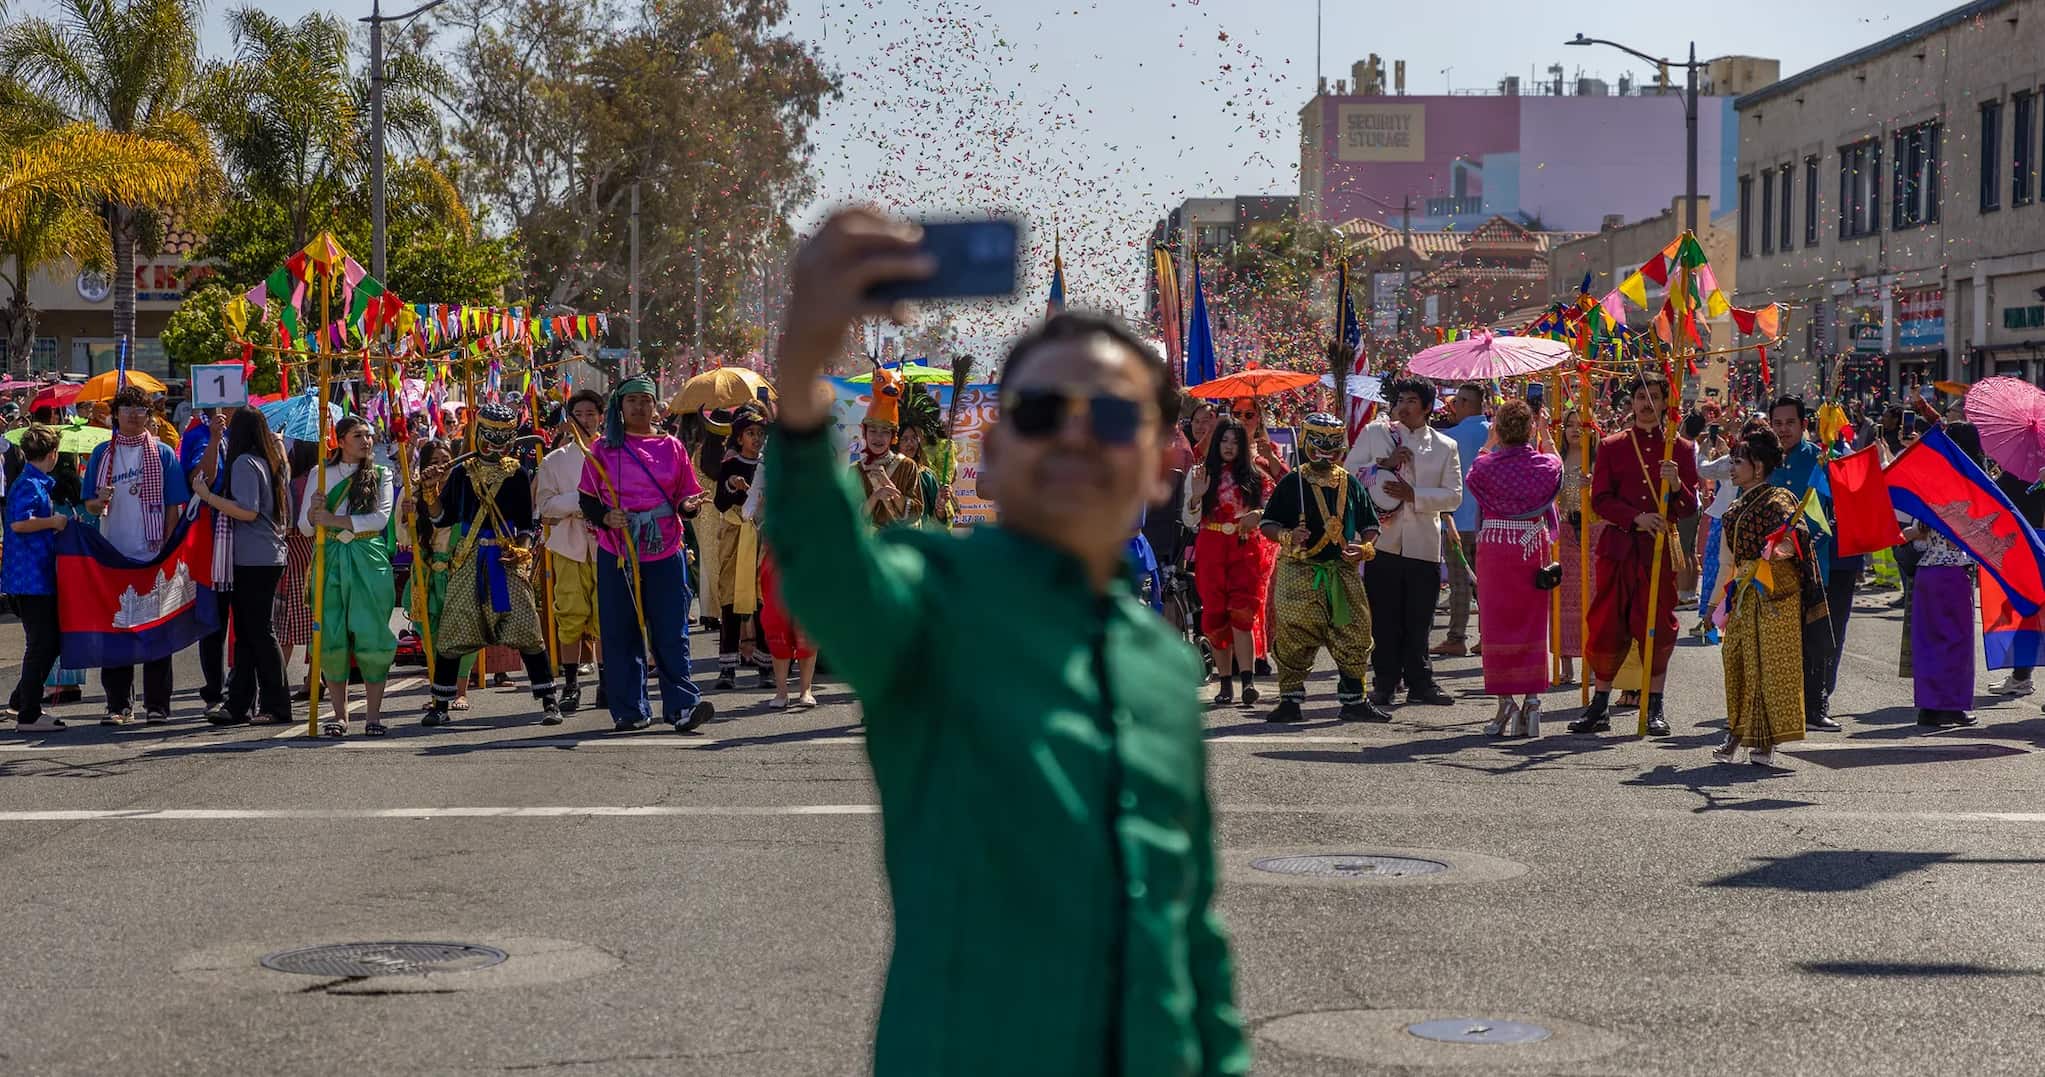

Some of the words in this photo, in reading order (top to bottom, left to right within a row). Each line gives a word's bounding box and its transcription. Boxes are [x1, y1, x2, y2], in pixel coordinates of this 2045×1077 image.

[1347, 113, 1412, 129] SECURITY
[1348, 131, 1409, 148] STORAGE
[213, 375, 225, 398] 1
